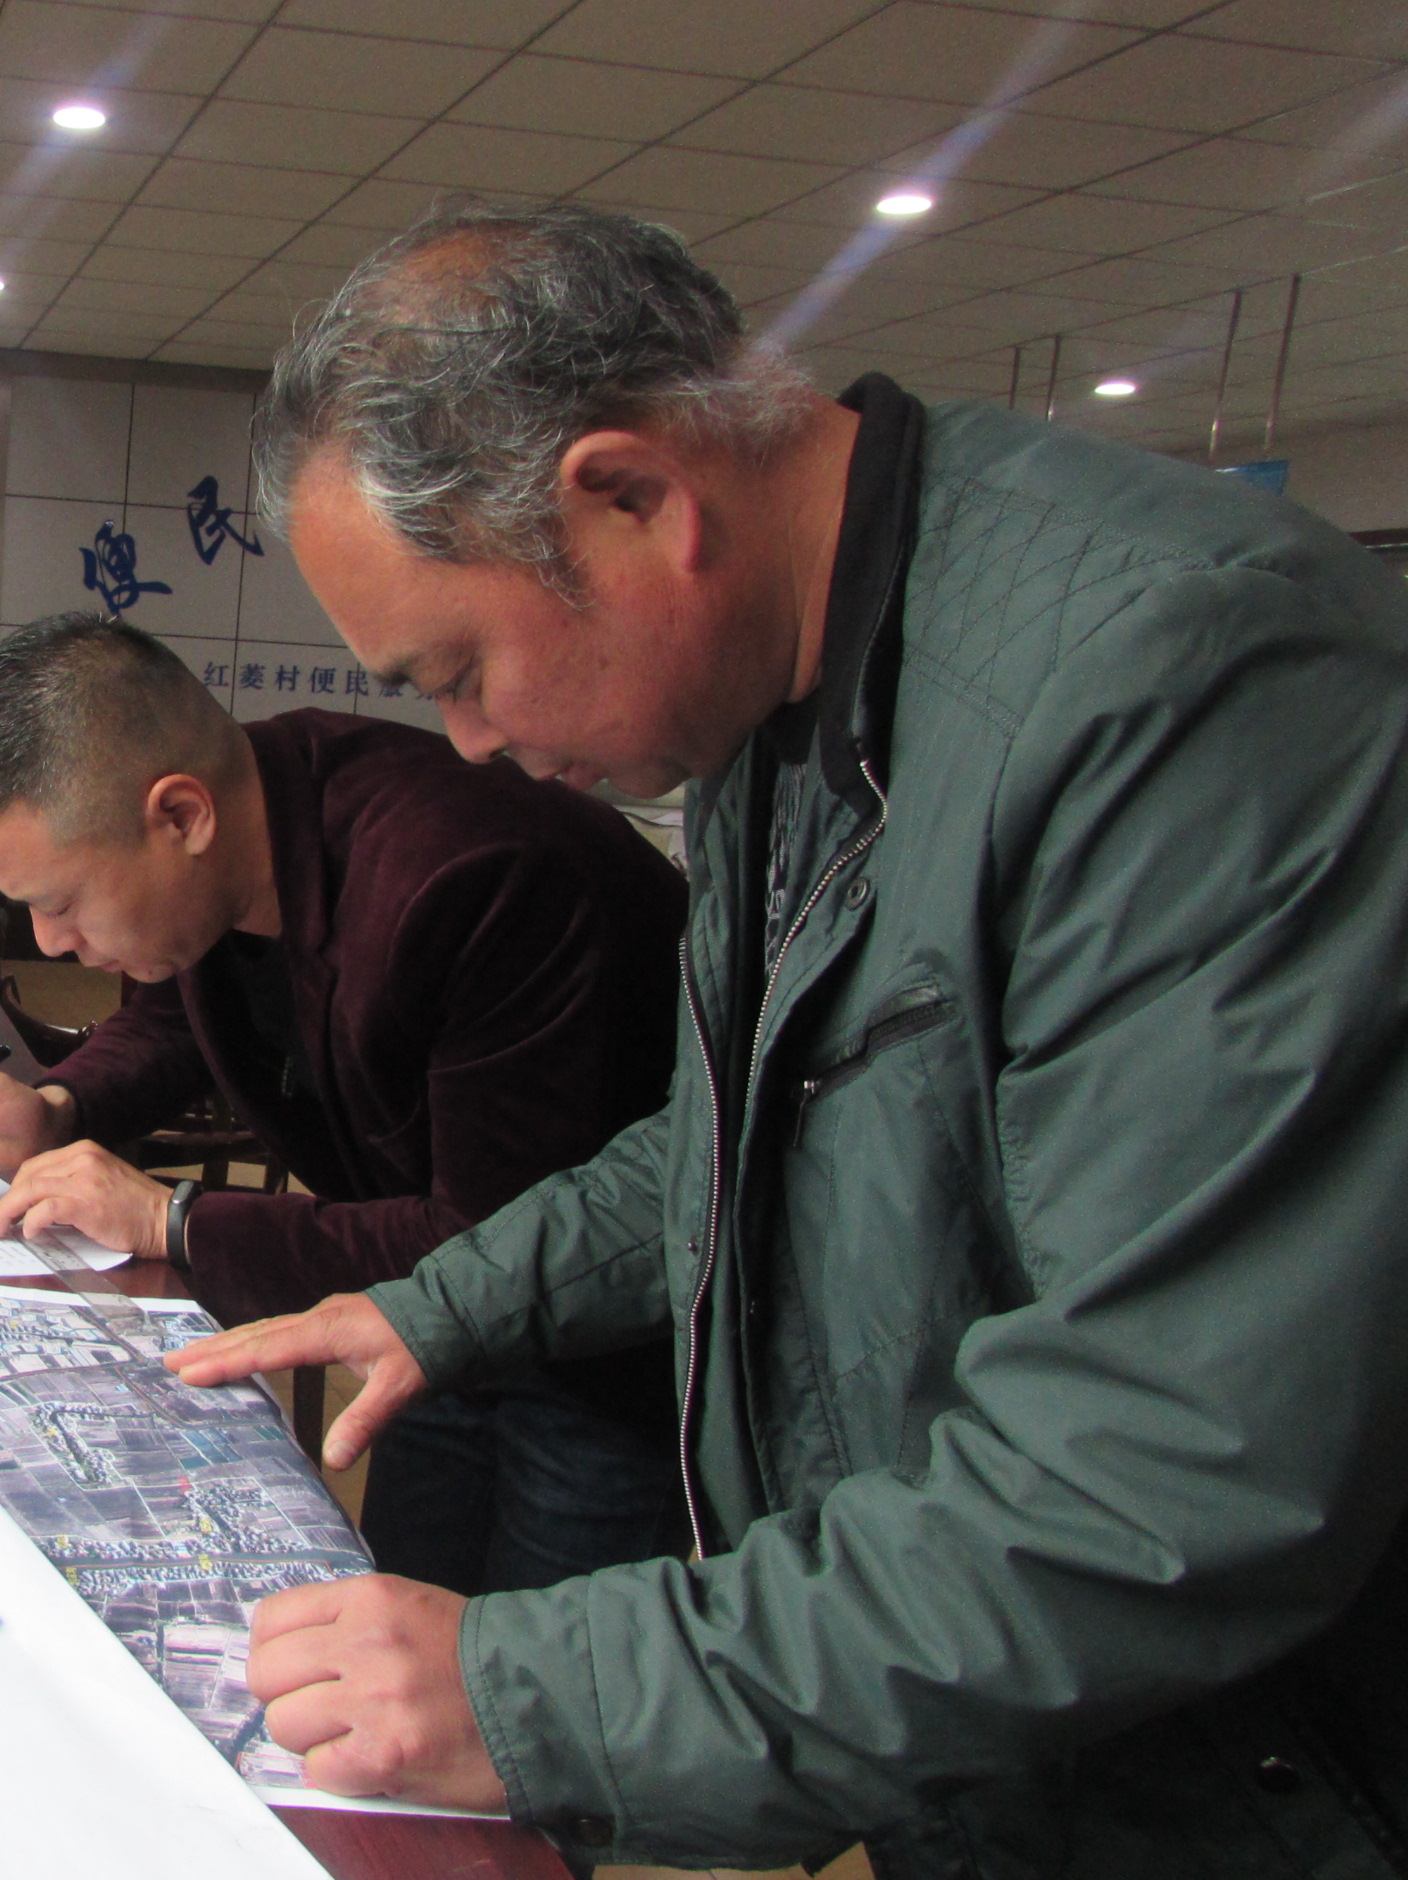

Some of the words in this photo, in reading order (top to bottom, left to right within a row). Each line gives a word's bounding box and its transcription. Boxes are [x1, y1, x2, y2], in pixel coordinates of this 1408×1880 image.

[203, 661, 434, 700] 红菱村便民
